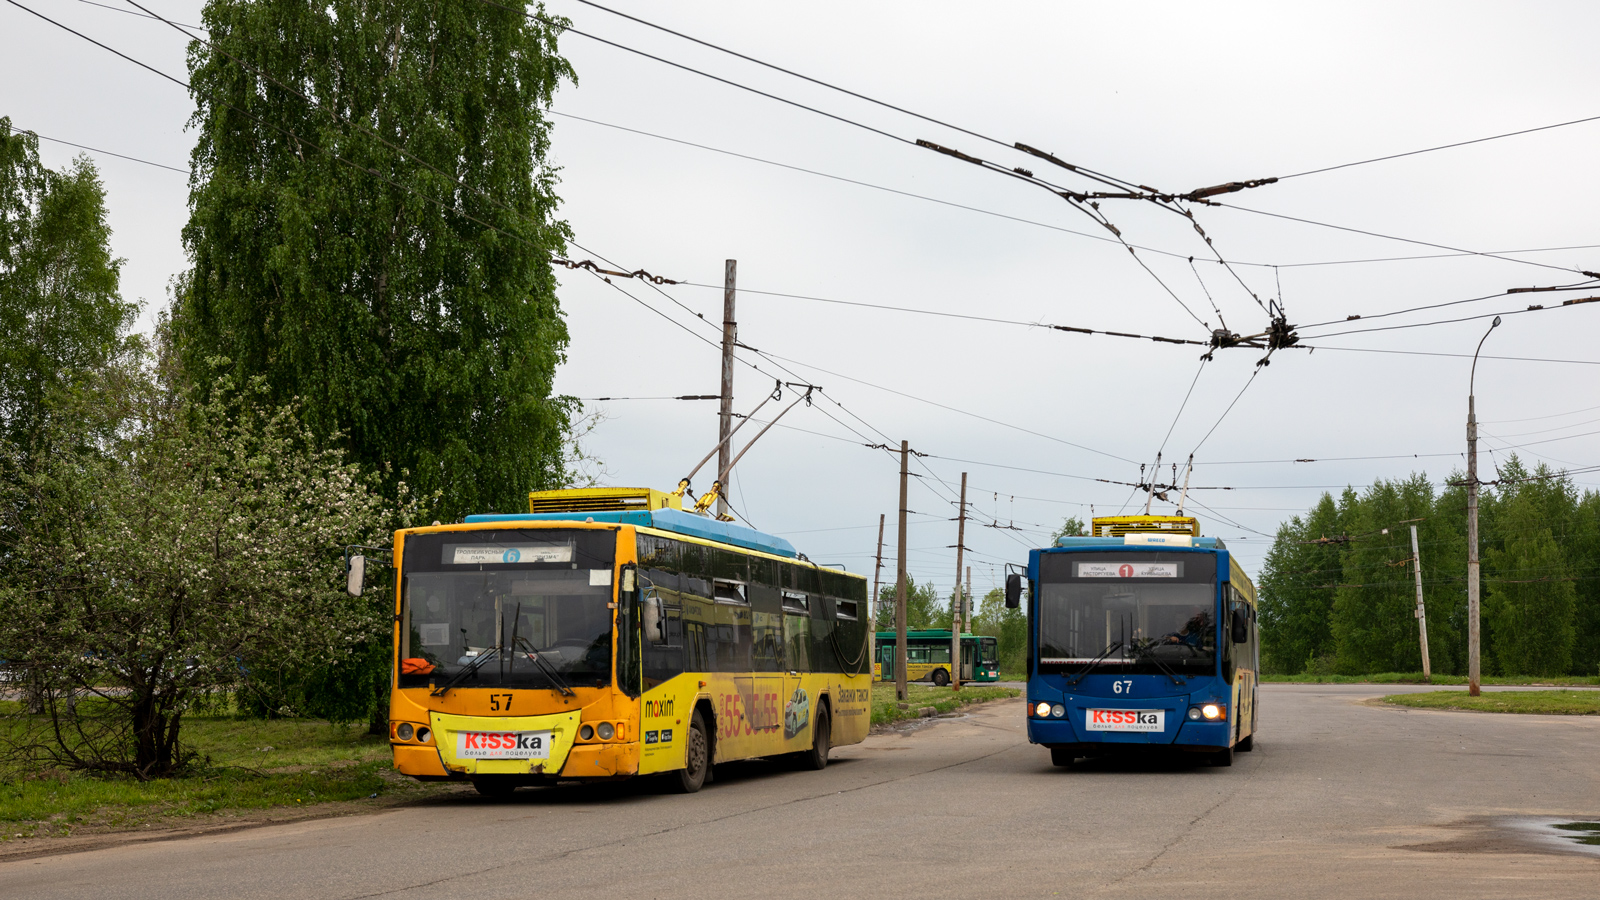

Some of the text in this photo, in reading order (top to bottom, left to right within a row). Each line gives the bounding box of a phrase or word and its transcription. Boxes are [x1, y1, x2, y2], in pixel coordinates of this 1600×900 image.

[507, 550, 517, 563] 6
[1122, 566, 1130, 577] 1
[1113, 680, 1133, 694] 67
[490, 693, 513, 711] 57
[645, 693, 674, 718] maxim
